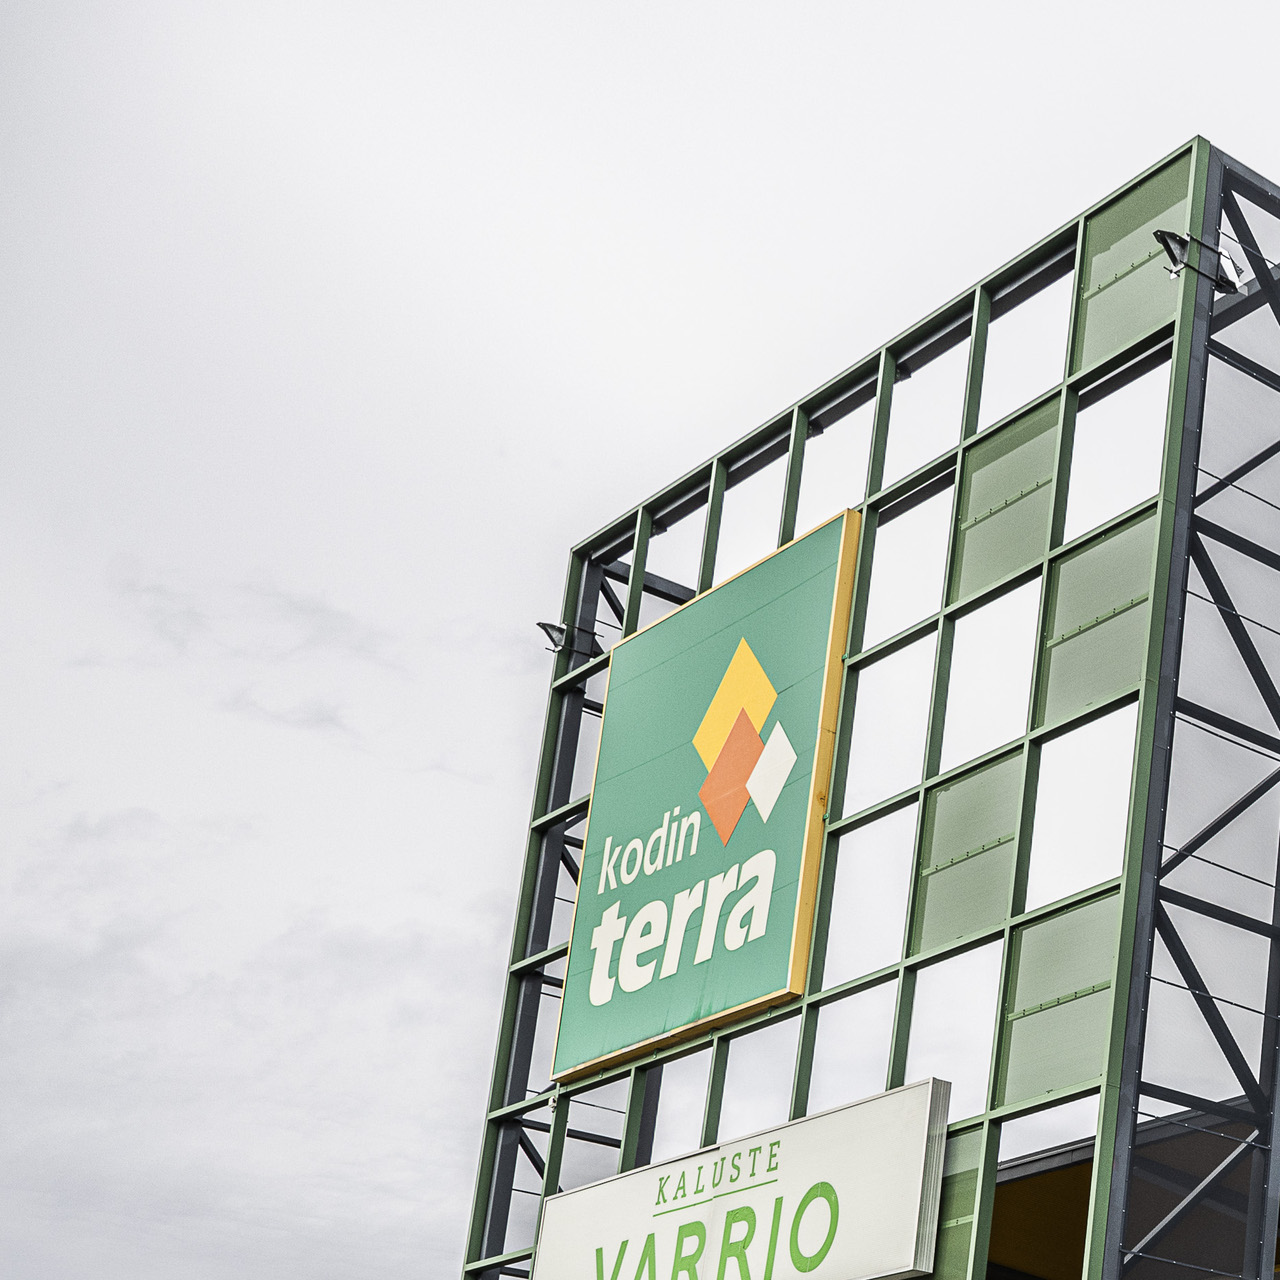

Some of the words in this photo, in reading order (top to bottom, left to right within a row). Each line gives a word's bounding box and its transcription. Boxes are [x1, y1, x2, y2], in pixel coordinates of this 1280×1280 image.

[597, 805, 702, 894] kodin
[588, 849, 777, 1006] terra
[654, 1140, 781, 1206] KALUSTE
